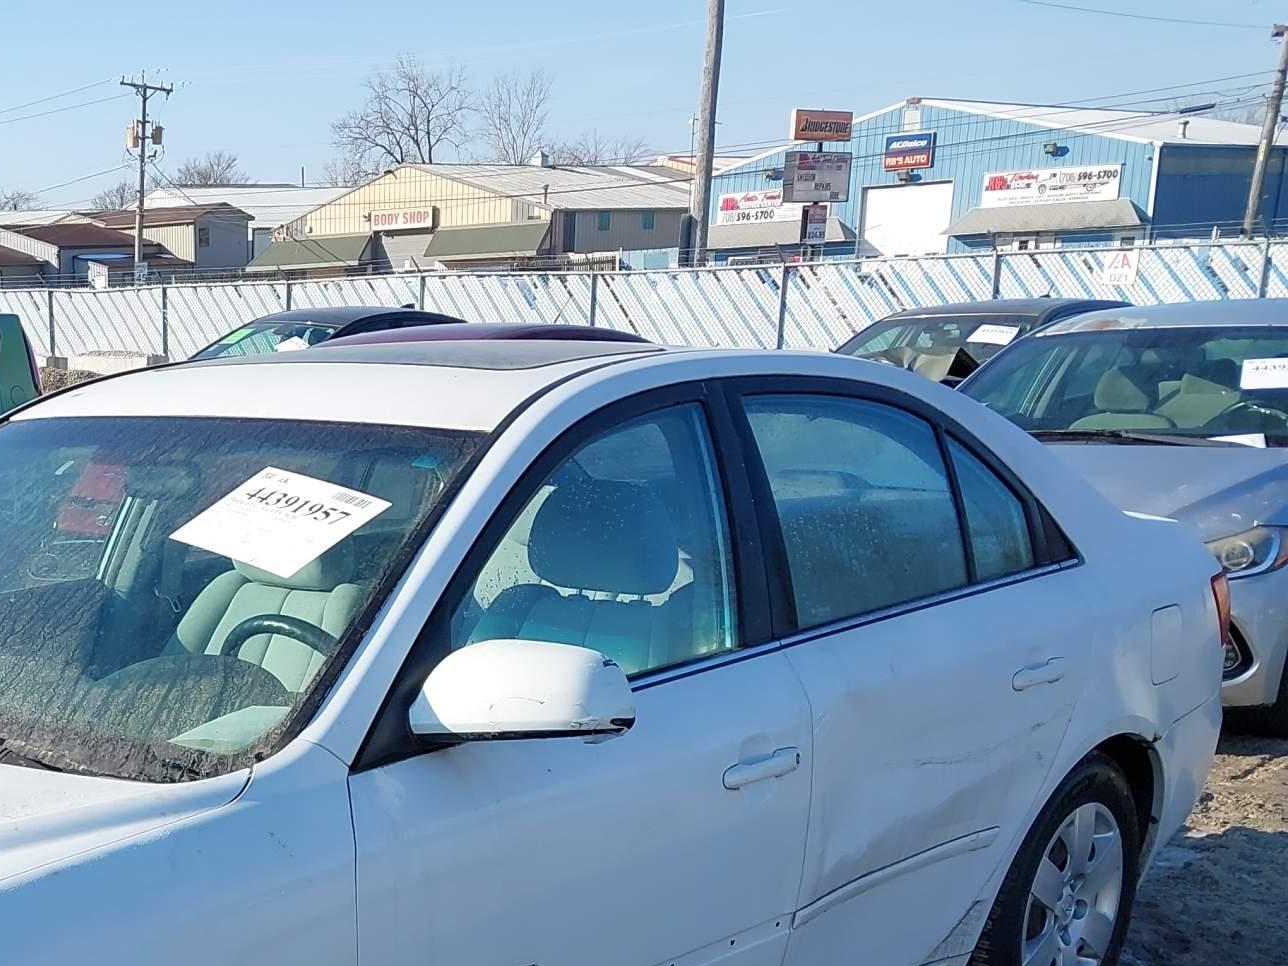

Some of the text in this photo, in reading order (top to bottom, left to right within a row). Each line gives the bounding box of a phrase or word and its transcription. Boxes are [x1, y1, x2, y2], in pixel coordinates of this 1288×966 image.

[800, 117, 850, 132] BRIDGESTONE
[889, 140, 928, 149] ACDelco
[904, 155, 928, 164] AUTO
[373, 210, 430, 226] BODY SHOP
[245, 487, 353, 525] 44391957
